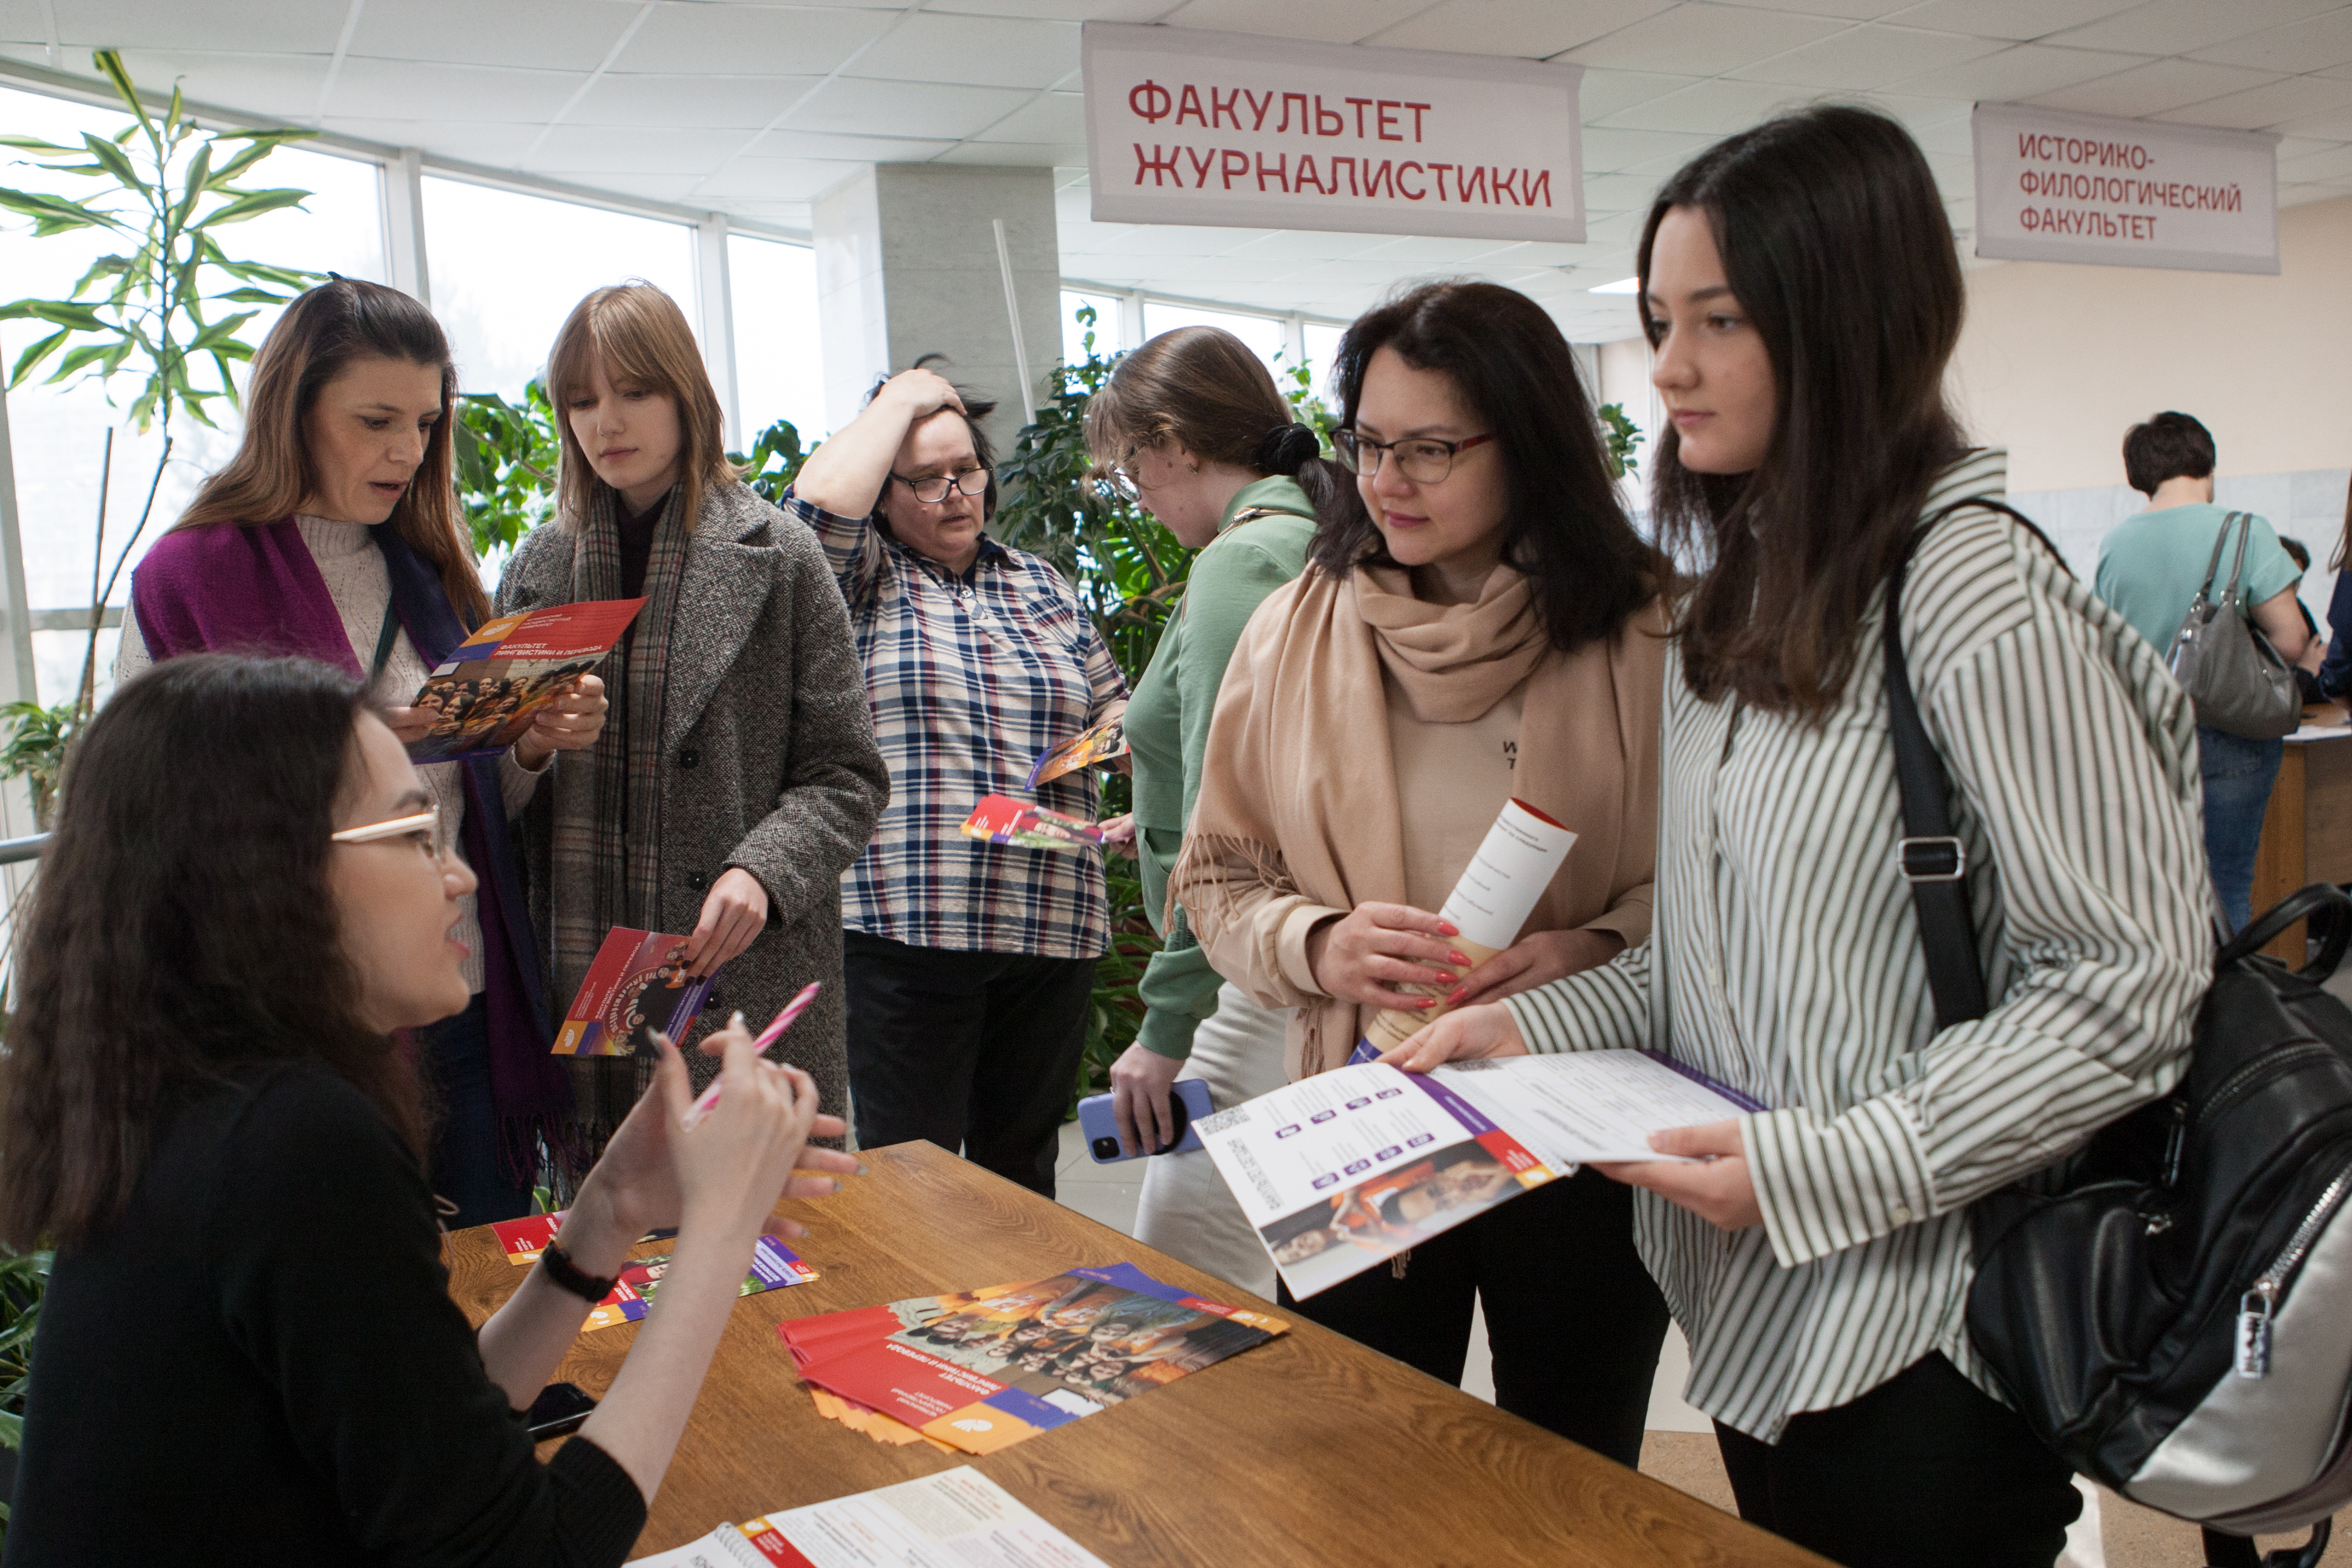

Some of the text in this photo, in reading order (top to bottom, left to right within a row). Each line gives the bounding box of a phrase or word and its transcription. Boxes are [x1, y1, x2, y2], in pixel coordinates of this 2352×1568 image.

[1128, 79, 1431, 143] ФАКУЛЬТЕТ
[2018, 132, 2155, 170] ИСТОРИКО-
[1132, 143, 1552, 207] ЖУРНАЛИСТИКИ
[2019, 170, 2241, 212] ФИЛОЛОГИЧЕСКИЙ
[2019, 206, 2157, 240] ФАКУЛЬТЕТ
